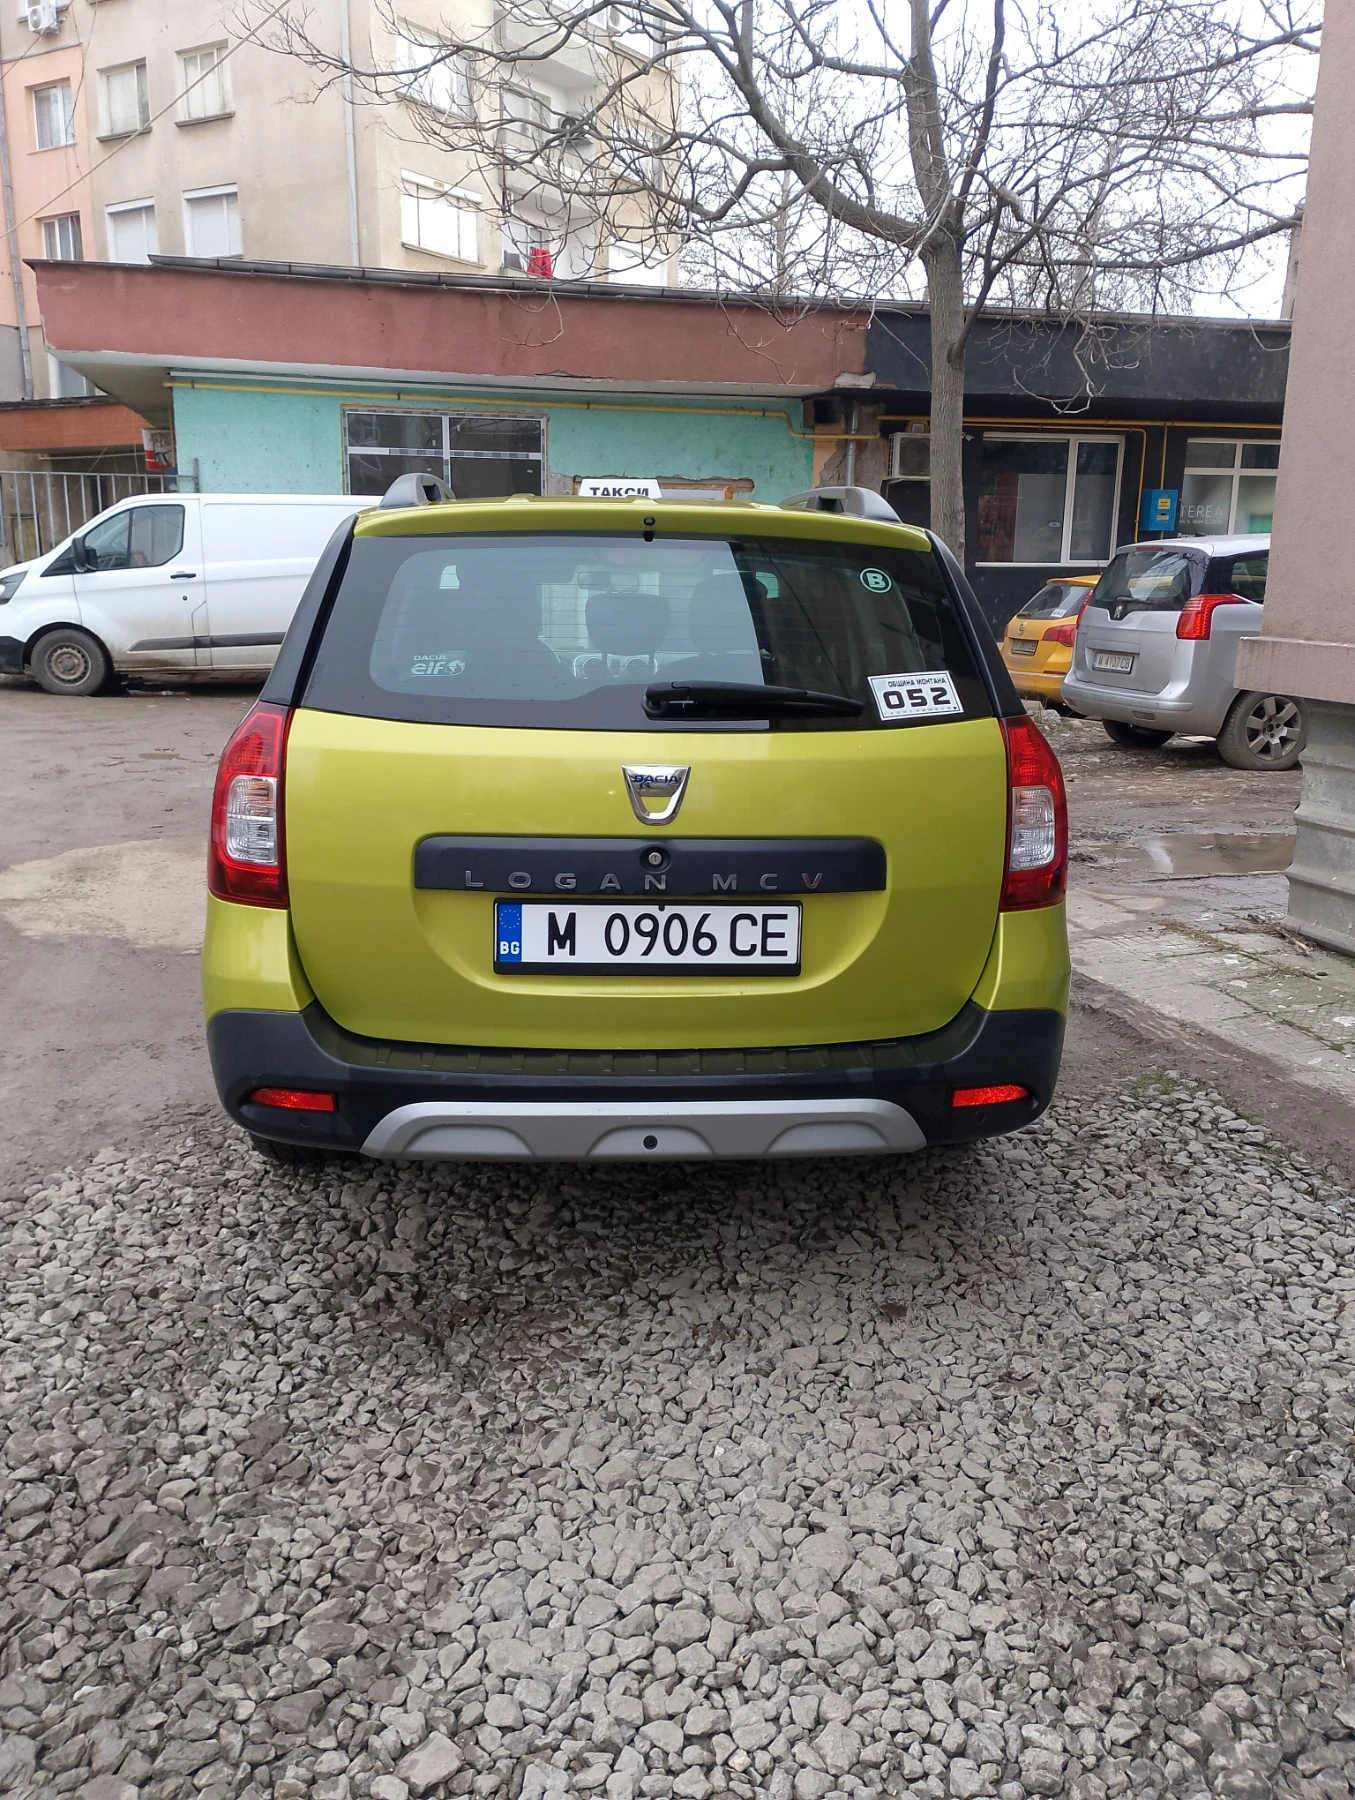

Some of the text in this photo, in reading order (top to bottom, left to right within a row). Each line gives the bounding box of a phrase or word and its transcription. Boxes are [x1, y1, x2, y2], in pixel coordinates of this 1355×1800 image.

[589, 486, 649, 497] ТАКСИ
[1180, 504, 1224, 518] TEREA
[410, 661, 446, 675] elf
[887, 677, 947, 688] ОБЩИНА МОНТАНА
[882, 686, 951, 710] 052
[634, 774, 679, 784] DACIA
[464, 870, 823, 891] LOGAN MCV
[547, 911, 789, 957] M 0906 CE
[499, 941, 520, 955] BG
